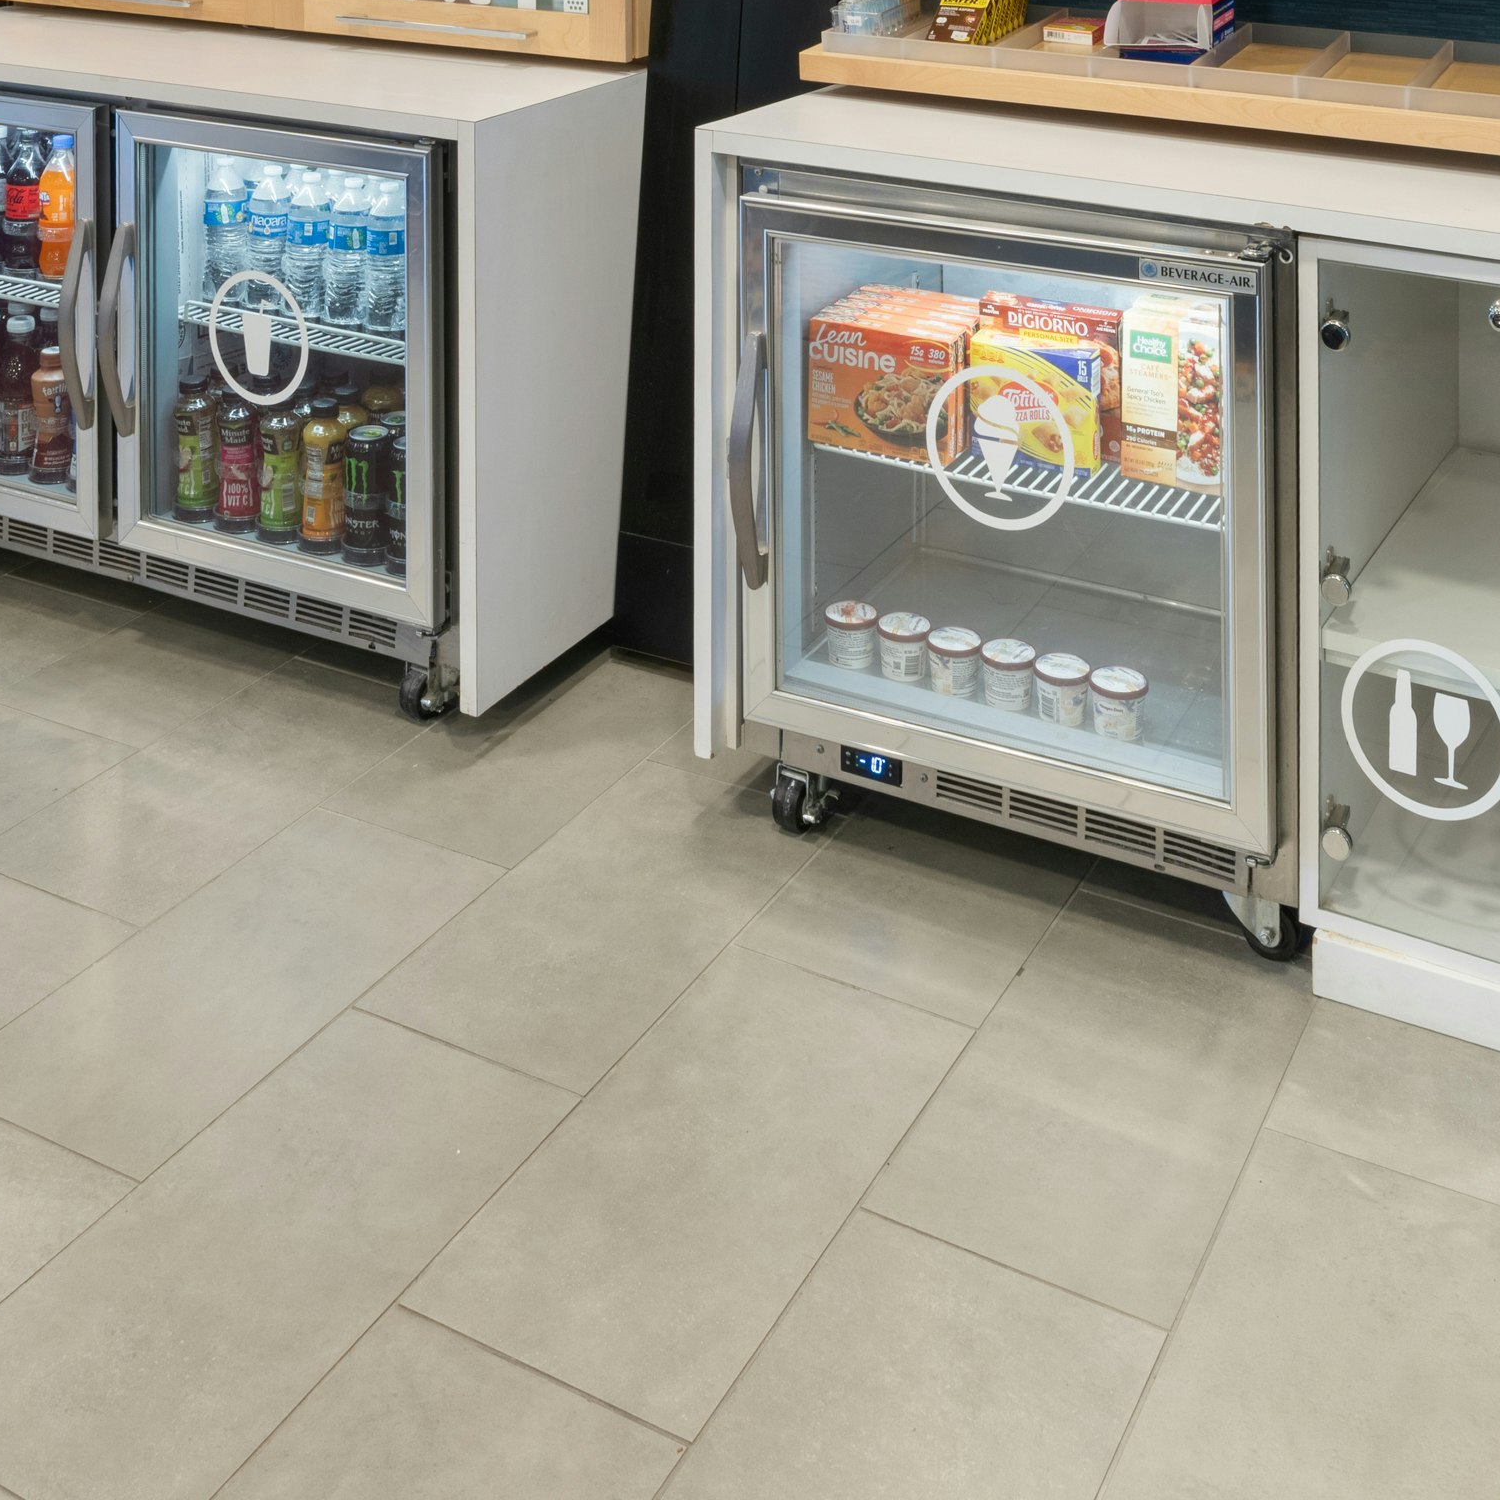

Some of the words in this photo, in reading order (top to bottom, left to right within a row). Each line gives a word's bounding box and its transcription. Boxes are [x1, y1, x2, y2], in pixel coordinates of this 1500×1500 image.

[250, 215, 288, 230] niagara
[1160, 266, 1250, 288] BEVERAGE-AIR
[815, 324, 867, 347] Lean
[1023, 331, 1059, 341] PERSONAL
[1137, 335, 1167, 350] Healthy
[928, 348, 945, 361] 380
[1078, 361, 1087, 376] 15
[812, 369, 834, 383] SESAME
[812, 382, 836, 396] CHICKEN
[1126, 386, 1148, 396] General
[1126, 393, 1142, 403] Spicy
[1143, 396, 1166, 405] Chicken
[221, 429, 251, 438] Minute
[1137, 428, 1165, 439] PROTEIN
[224, 436, 247, 444] Maid
[228, 483, 249, 494] 100%
[228, 495, 240, 507] VIT
[242, 495, 248, 505] C
